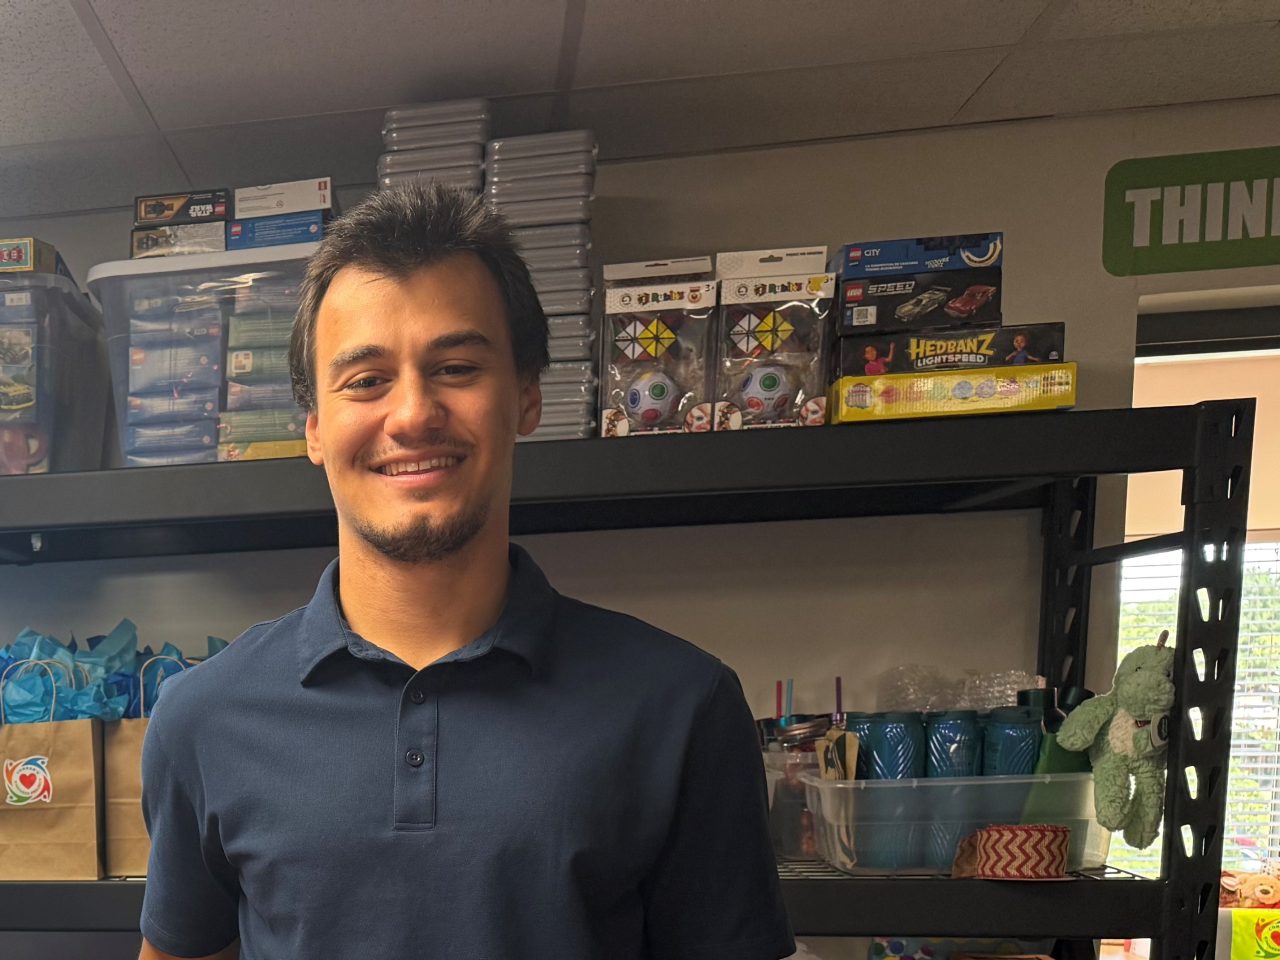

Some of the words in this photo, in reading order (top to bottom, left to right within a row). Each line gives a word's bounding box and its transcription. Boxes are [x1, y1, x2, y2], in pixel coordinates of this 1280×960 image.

[864, 248, 880, 257] CITY
[868, 281, 915, 294] SPEED
[907, 333, 996, 360] HEDBANZ
[916, 354, 984, 367] LIGHTSPEED
